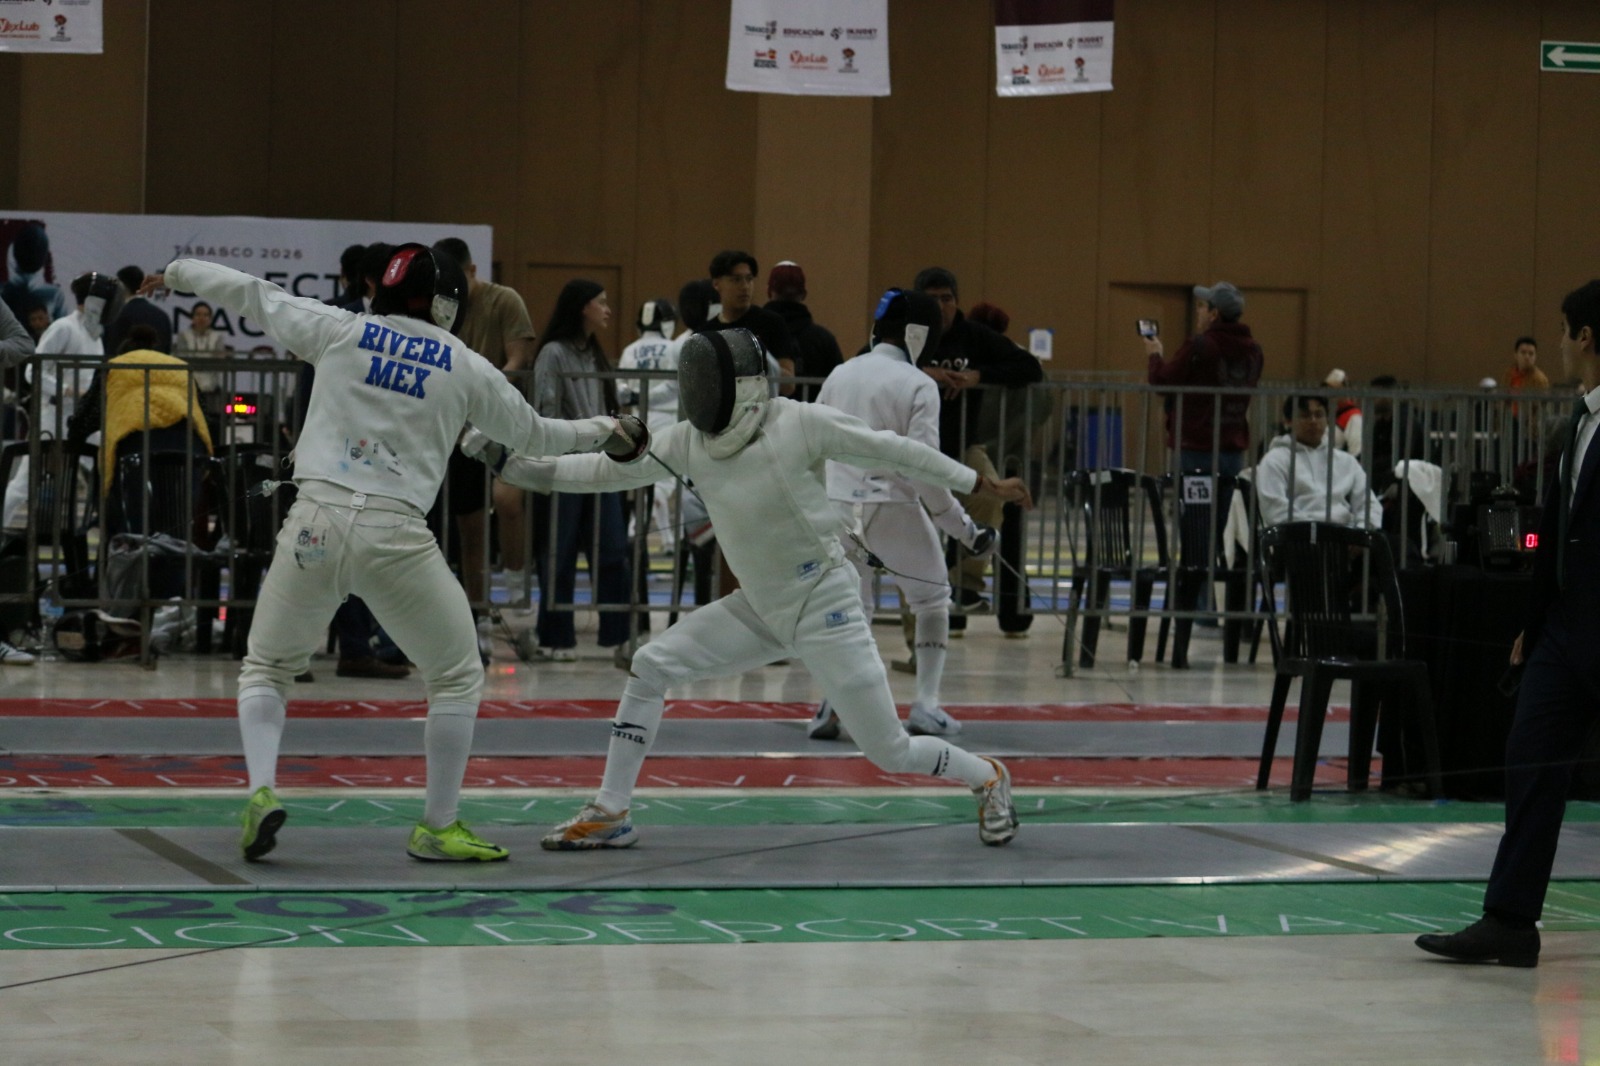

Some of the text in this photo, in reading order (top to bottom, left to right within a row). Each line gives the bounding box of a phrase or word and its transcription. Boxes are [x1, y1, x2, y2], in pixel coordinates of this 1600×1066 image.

[174, 245, 303, 259] TABASCO 2026
[358, 321, 452, 372] RIVERA
[365, 356, 431, 400] MEX
[611, 730, 646, 745] oma
